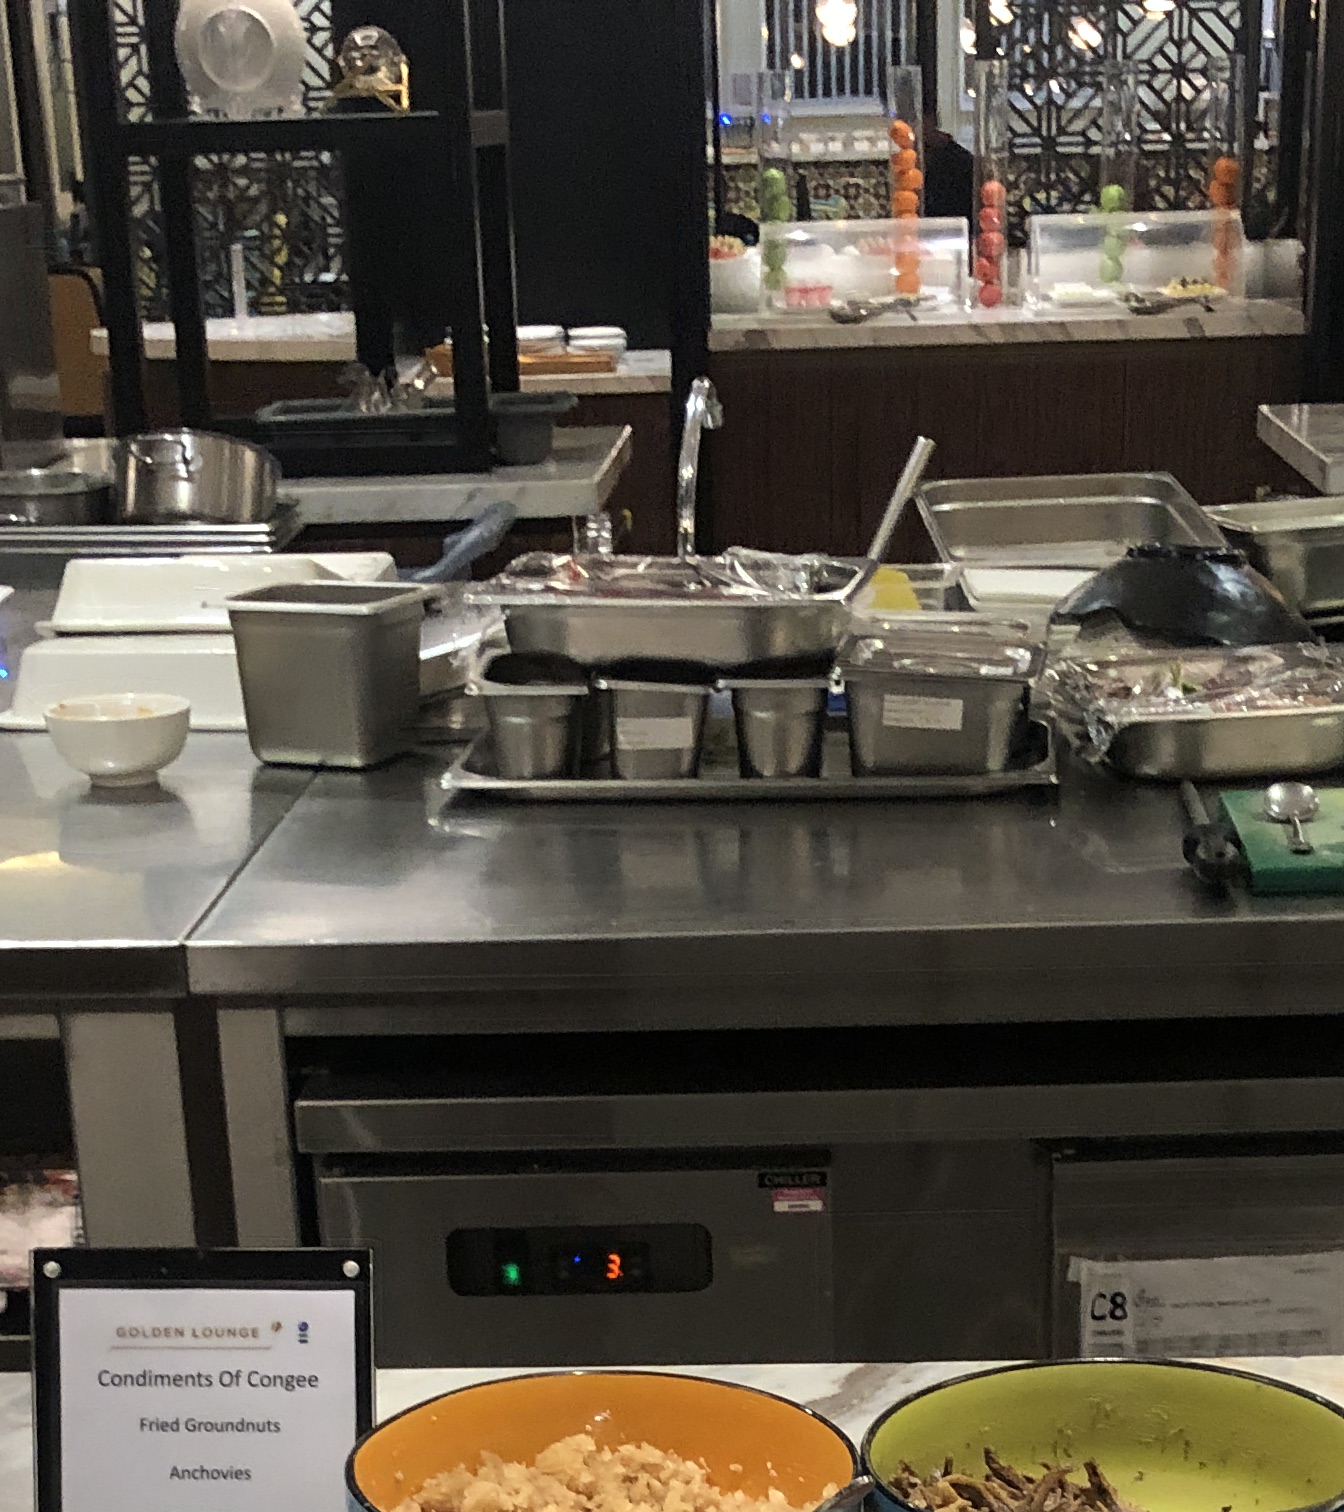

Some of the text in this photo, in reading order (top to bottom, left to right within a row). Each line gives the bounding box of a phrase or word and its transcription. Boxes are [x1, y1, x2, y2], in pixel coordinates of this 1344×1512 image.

[1090, 1291, 1129, 1321] C8
[115, 1326, 261, 1339] GOLDEN LOUNGE
[97, 1369, 319, 1392] Condiments Of Congee
[139, 1417, 281, 1433] Fried Groundnuts
[169, 1465, 252, 1481] Anchovies
